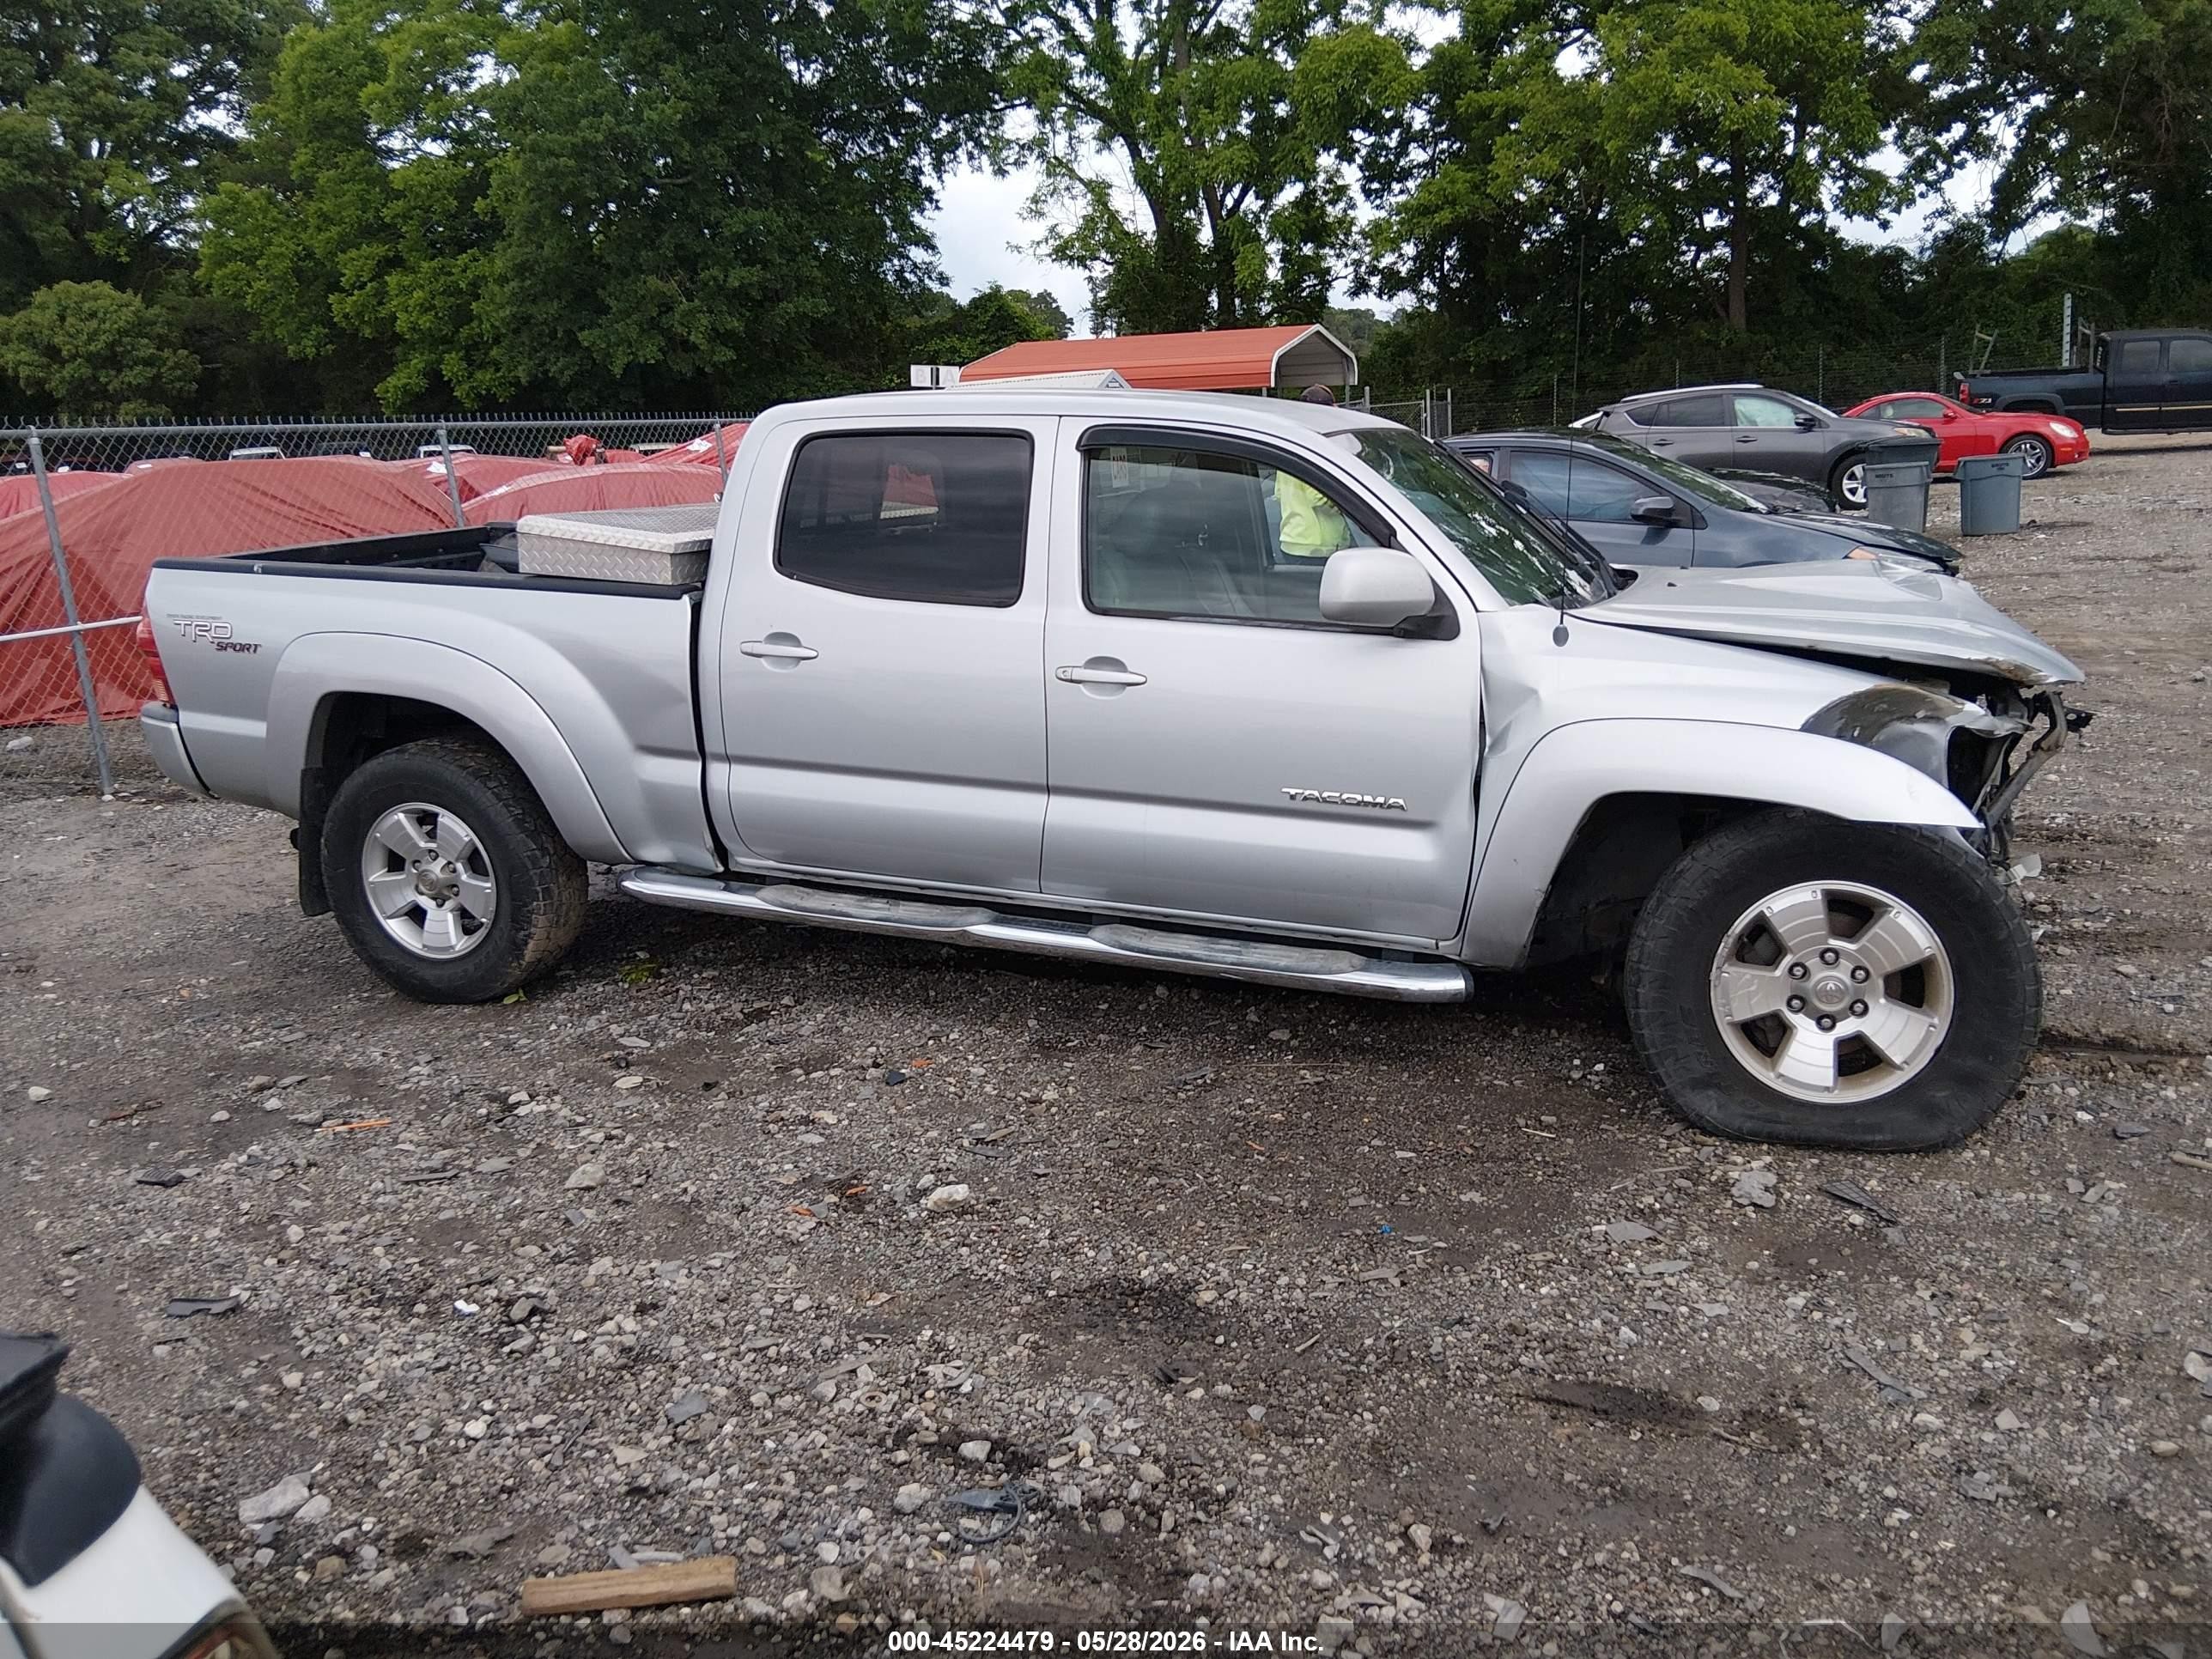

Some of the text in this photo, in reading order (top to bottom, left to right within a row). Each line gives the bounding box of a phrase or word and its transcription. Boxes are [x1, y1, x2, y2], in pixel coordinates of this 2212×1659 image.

[173, 619, 233, 643] TRD
[215, 641, 262, 654] SPORT
[1280, 787, 1407, 811] TACOMA
